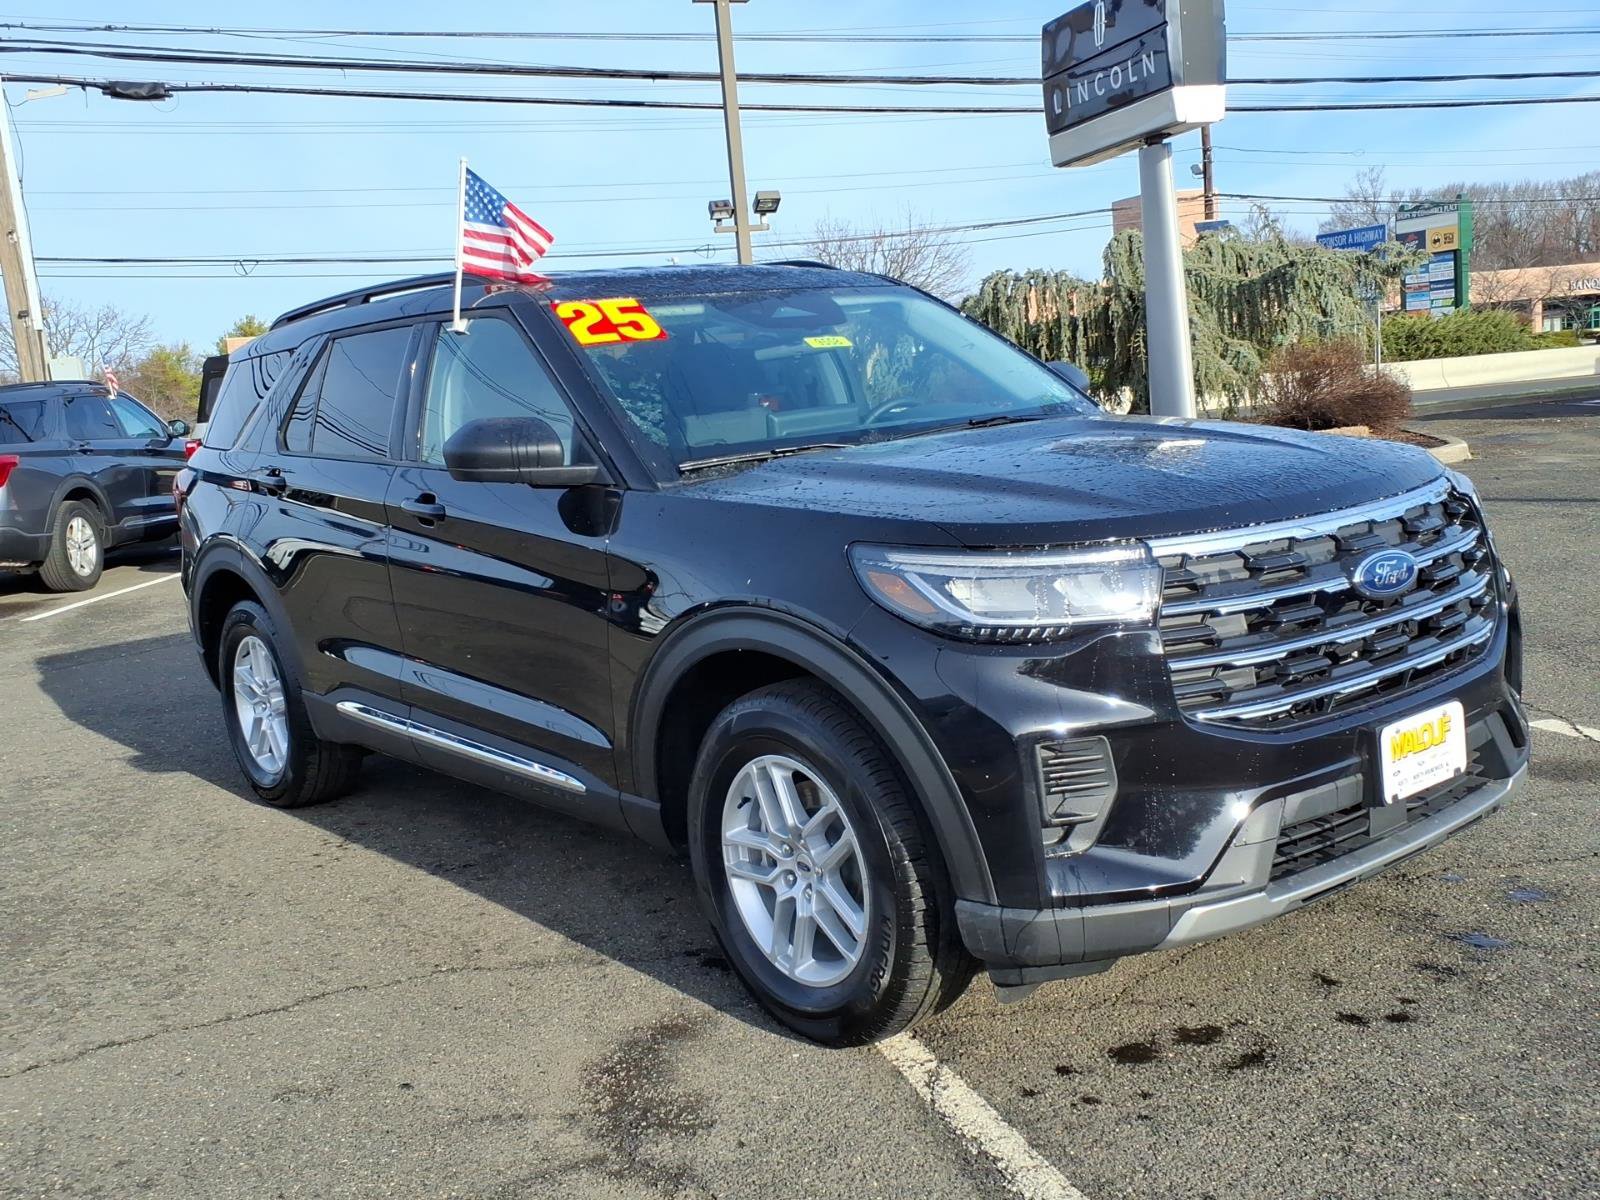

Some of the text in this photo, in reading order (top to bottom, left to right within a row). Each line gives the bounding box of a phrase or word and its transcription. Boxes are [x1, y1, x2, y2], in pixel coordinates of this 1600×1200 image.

[1053, 50, 1156, 115] LINCOLN
[1348, 233, 1353, 245] A
[1354, 228, 1384, 243] HIGHWAY
[555, 298, 662, 345] 25
[1374, 559, 1409, 587] Ford
[1390, 714, 1452, 763] MALOUF
